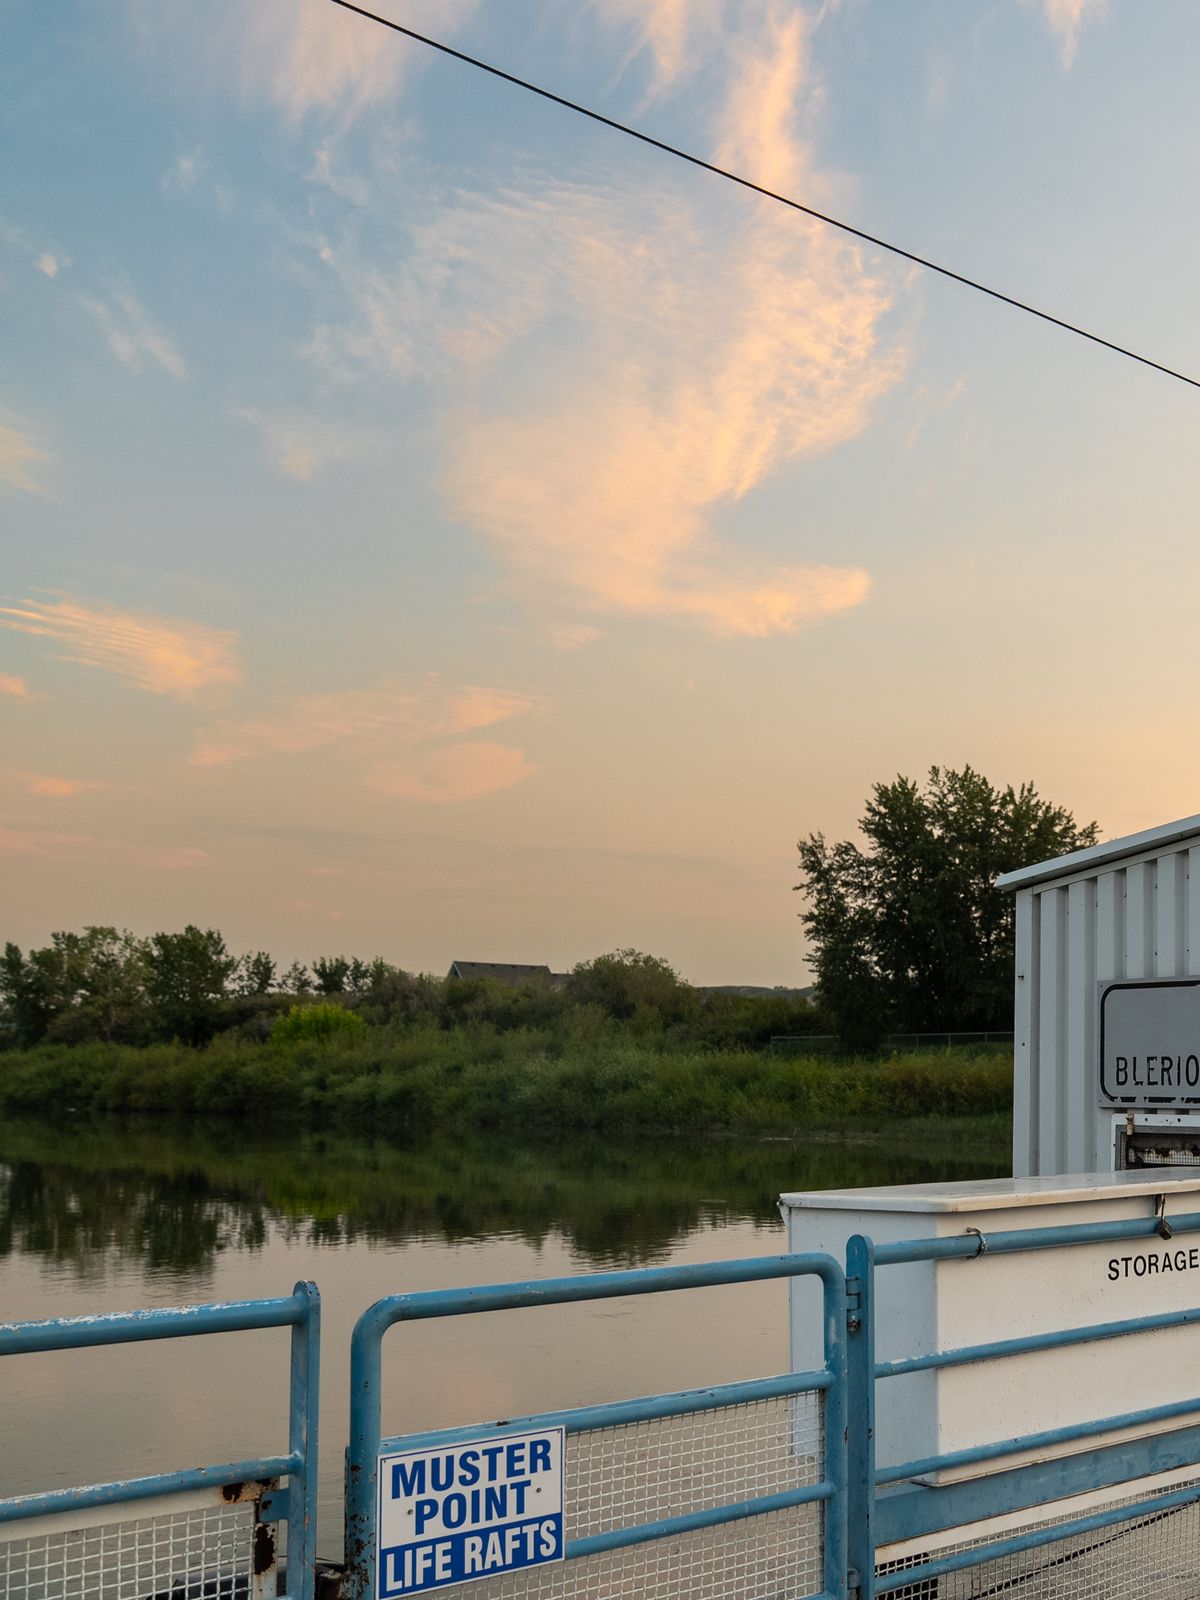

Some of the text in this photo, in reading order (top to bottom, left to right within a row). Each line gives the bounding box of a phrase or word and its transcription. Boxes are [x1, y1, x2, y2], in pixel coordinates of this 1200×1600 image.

[1107, 1248, 1200, 1281] STORAGE
[391, 1438, 552, 1500] MUSTER
[414, 1480, 532, 1535] POINT
[386, 1519, 557, 1592] LIFE RAFTS
